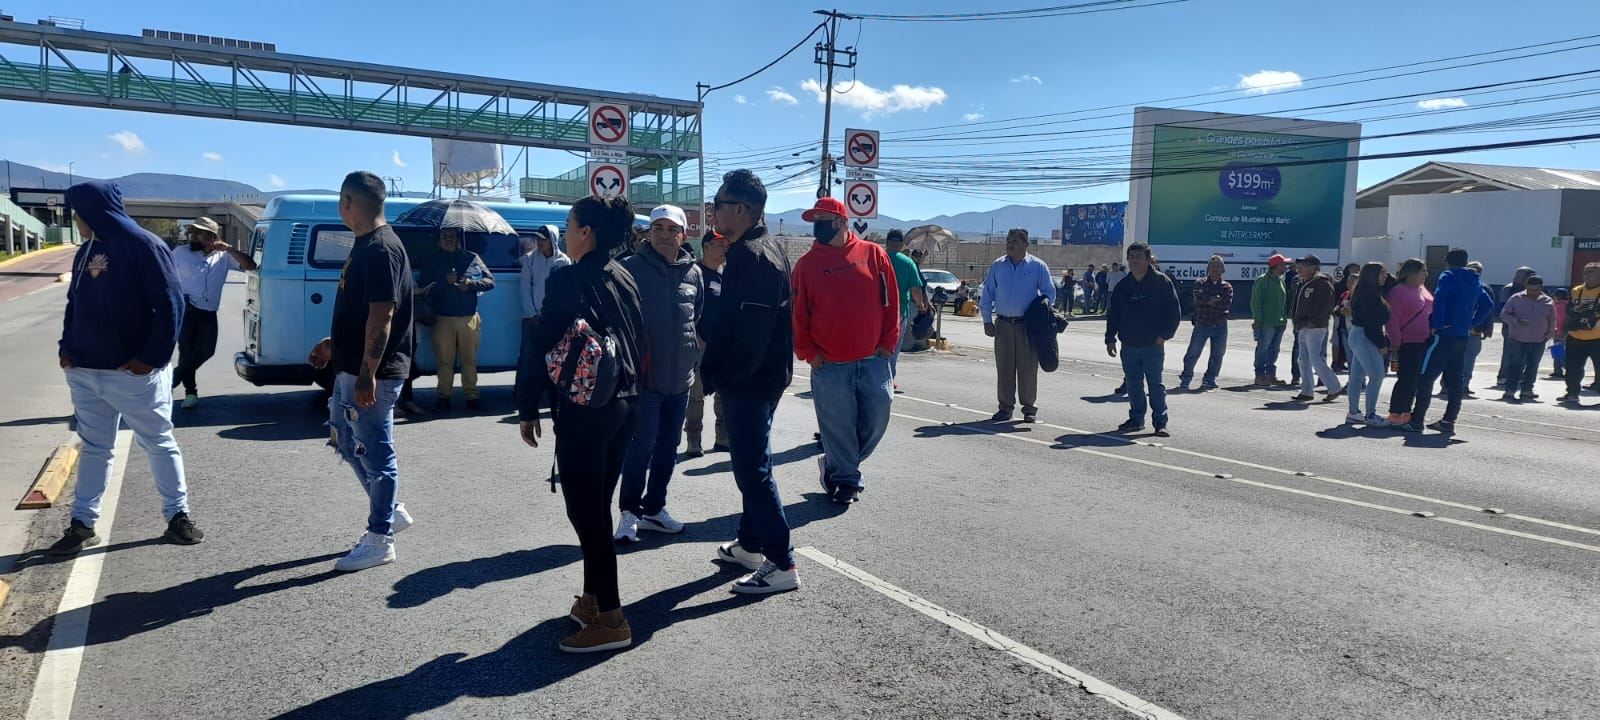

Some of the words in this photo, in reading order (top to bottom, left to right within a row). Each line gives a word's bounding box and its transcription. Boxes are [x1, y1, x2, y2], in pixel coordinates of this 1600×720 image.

[1206, 133, 1244, 145] Grandes
[1231, 215, 1240, 223] de
[1266, 216, 1274, 224] de
